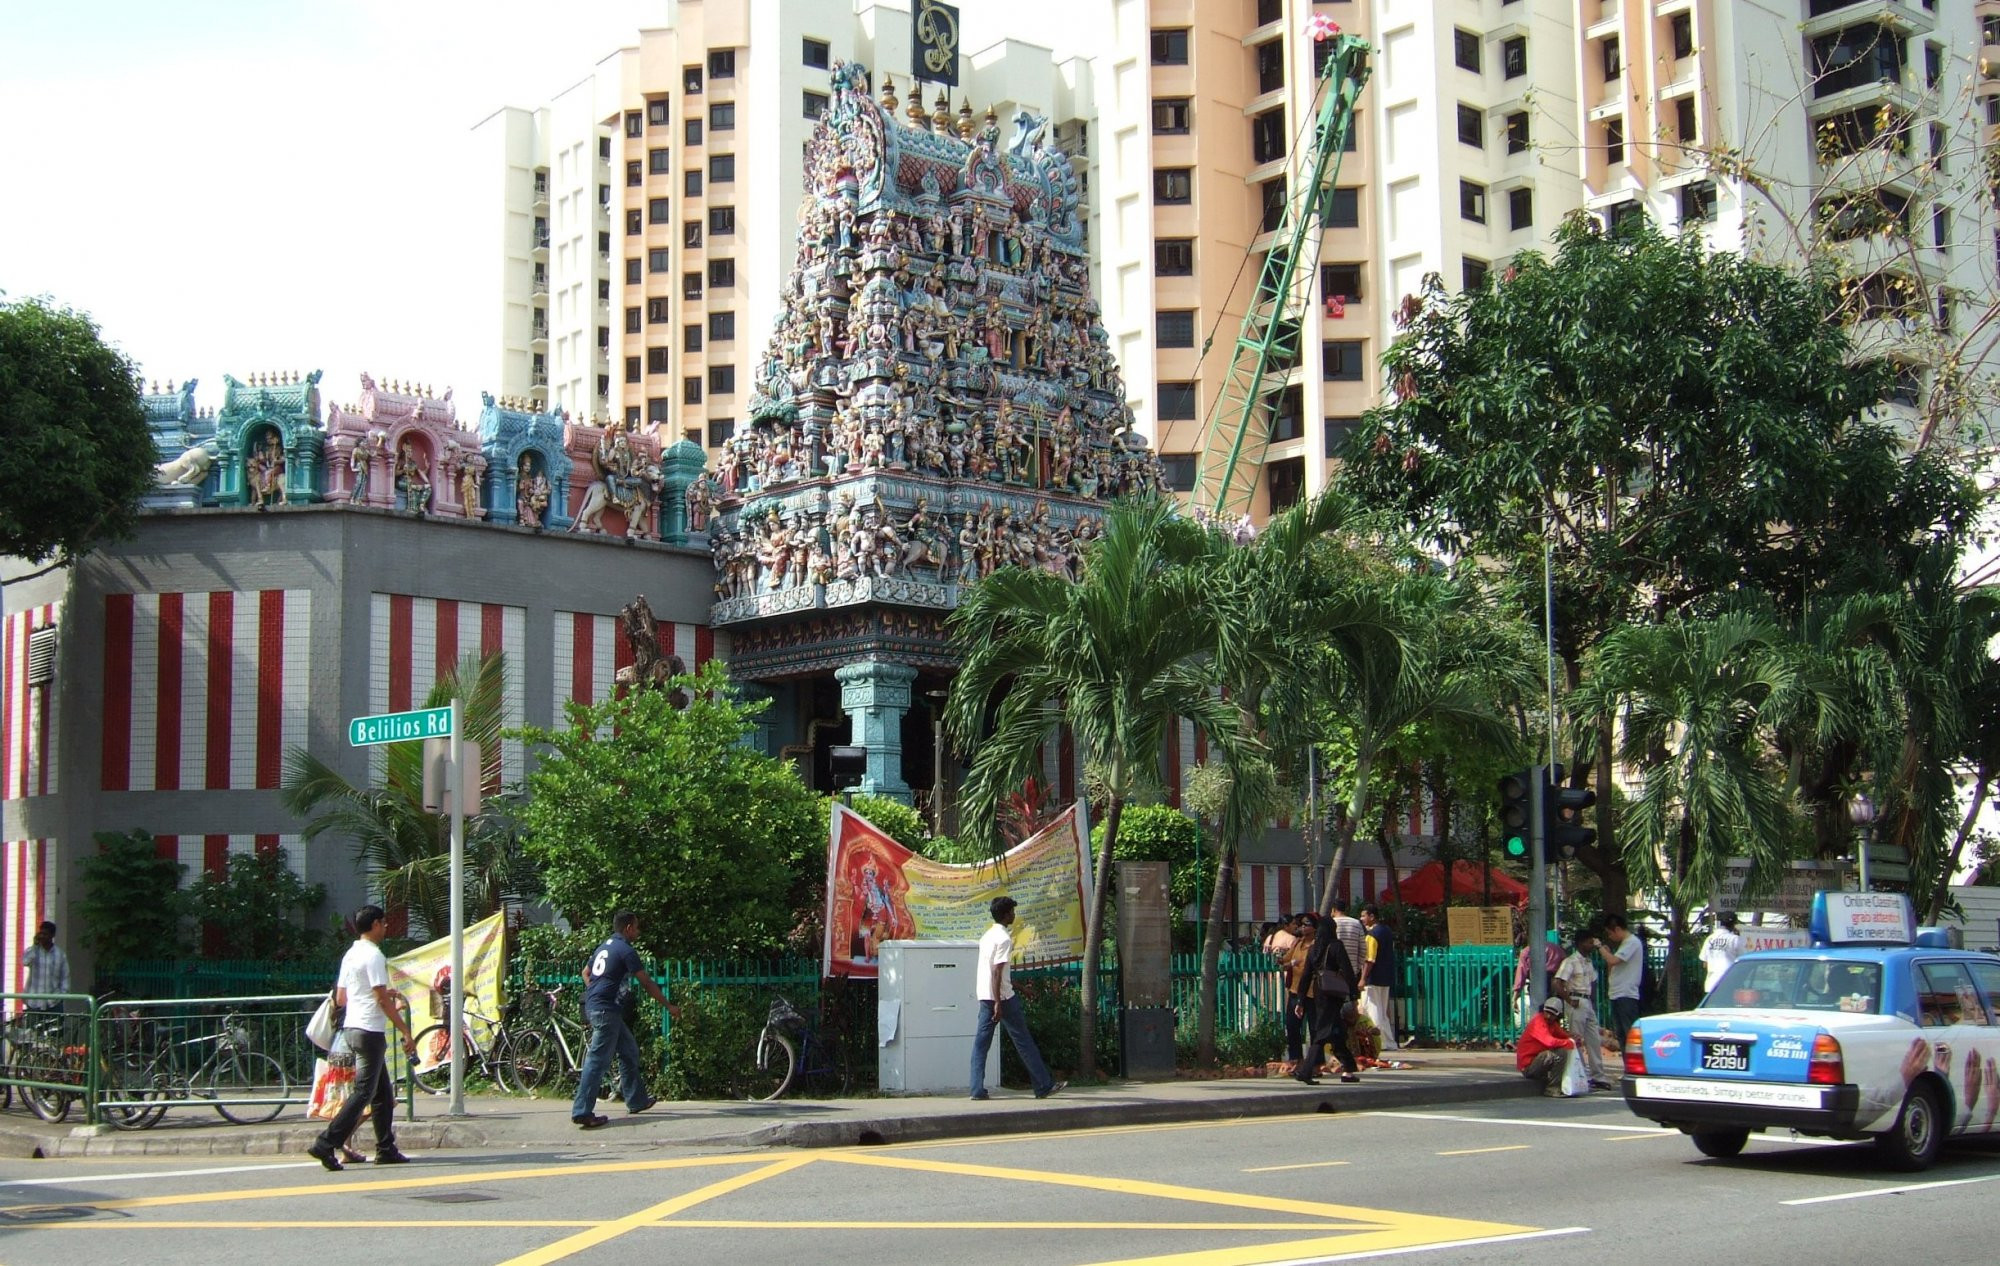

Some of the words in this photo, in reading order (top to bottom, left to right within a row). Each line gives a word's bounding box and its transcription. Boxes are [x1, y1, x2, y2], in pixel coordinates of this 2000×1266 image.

[357, 717, 420, 742] Belilios
[427, 711, 448, 734] Rd
[1843, 895, 1872, 907] Online
[1851, 911, 1871, 925] grab
[1864, 929, 1885, 938] never
[591, 949, 609, 977] 6
[1711, 1044, 1738, 1056] SHA
[1766, 1048, 1790, 1058] 6552
[1791, 1050, 1808, 1060] 1111
[1703, 1056, 1747, 1070] 7209U
[1647, 1082, 1662, 1092] The
[1713, 1086, 1743, 1099] Simply
[1745, 1089, 1774, 1100] better
